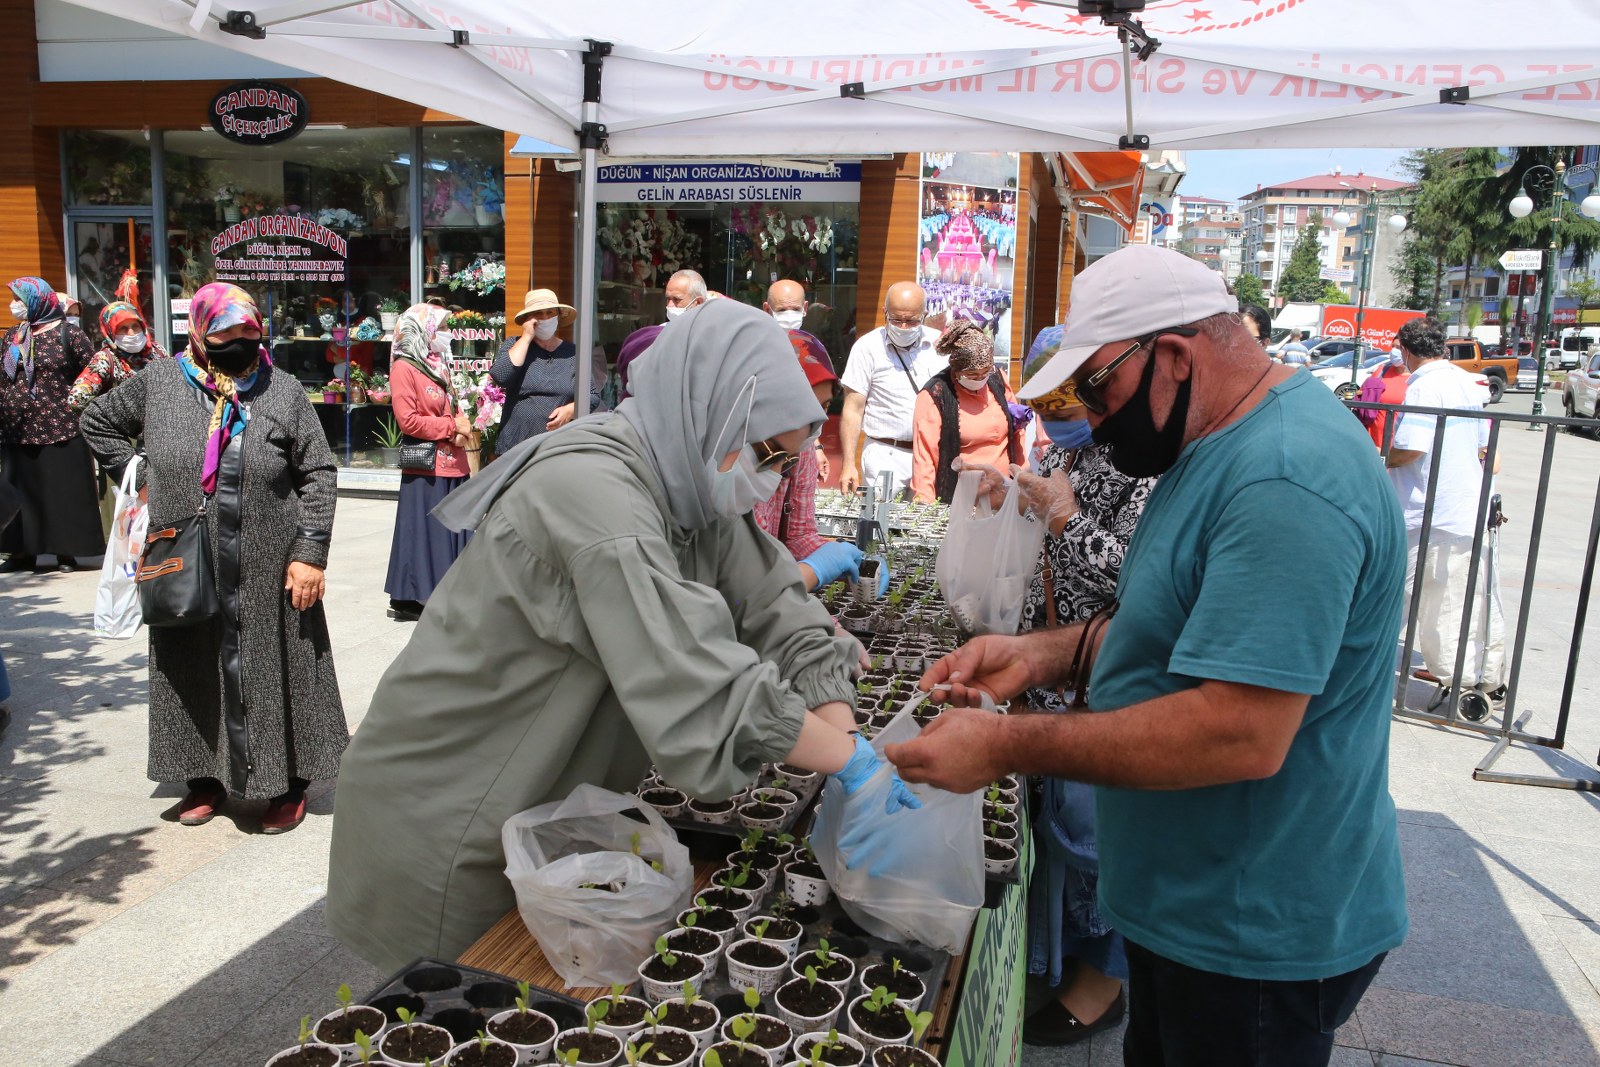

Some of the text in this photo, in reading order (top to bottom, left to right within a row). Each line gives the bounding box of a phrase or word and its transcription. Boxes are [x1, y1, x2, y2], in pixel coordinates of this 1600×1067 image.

[215, 88, 298, 116] CANDAN
[222, 113, 293, 139] ÇİÇEKÇİLİK
[601, 166, 641, 179] DÜĞÜN
[653, 165, 688, 181] NİŞAN
[691, 164, 793, 179] ORGANİZASYONU
[638, 185, 801, 201] GELİN ARABASI SÜSLENİR
[211, 212, 347, 258] CANDAN ORGANİZASYON
[277, 241, 301, 258] NİŞAN
[302, 247, 311, 256] ve
[215, 257, 233, 270] ÖZEL
[451, 328, 495, 340] ANDAN
[1329, 325, 1350, 335] DOĞUŞ
[1367, 328, 1384, 337] Güzel
